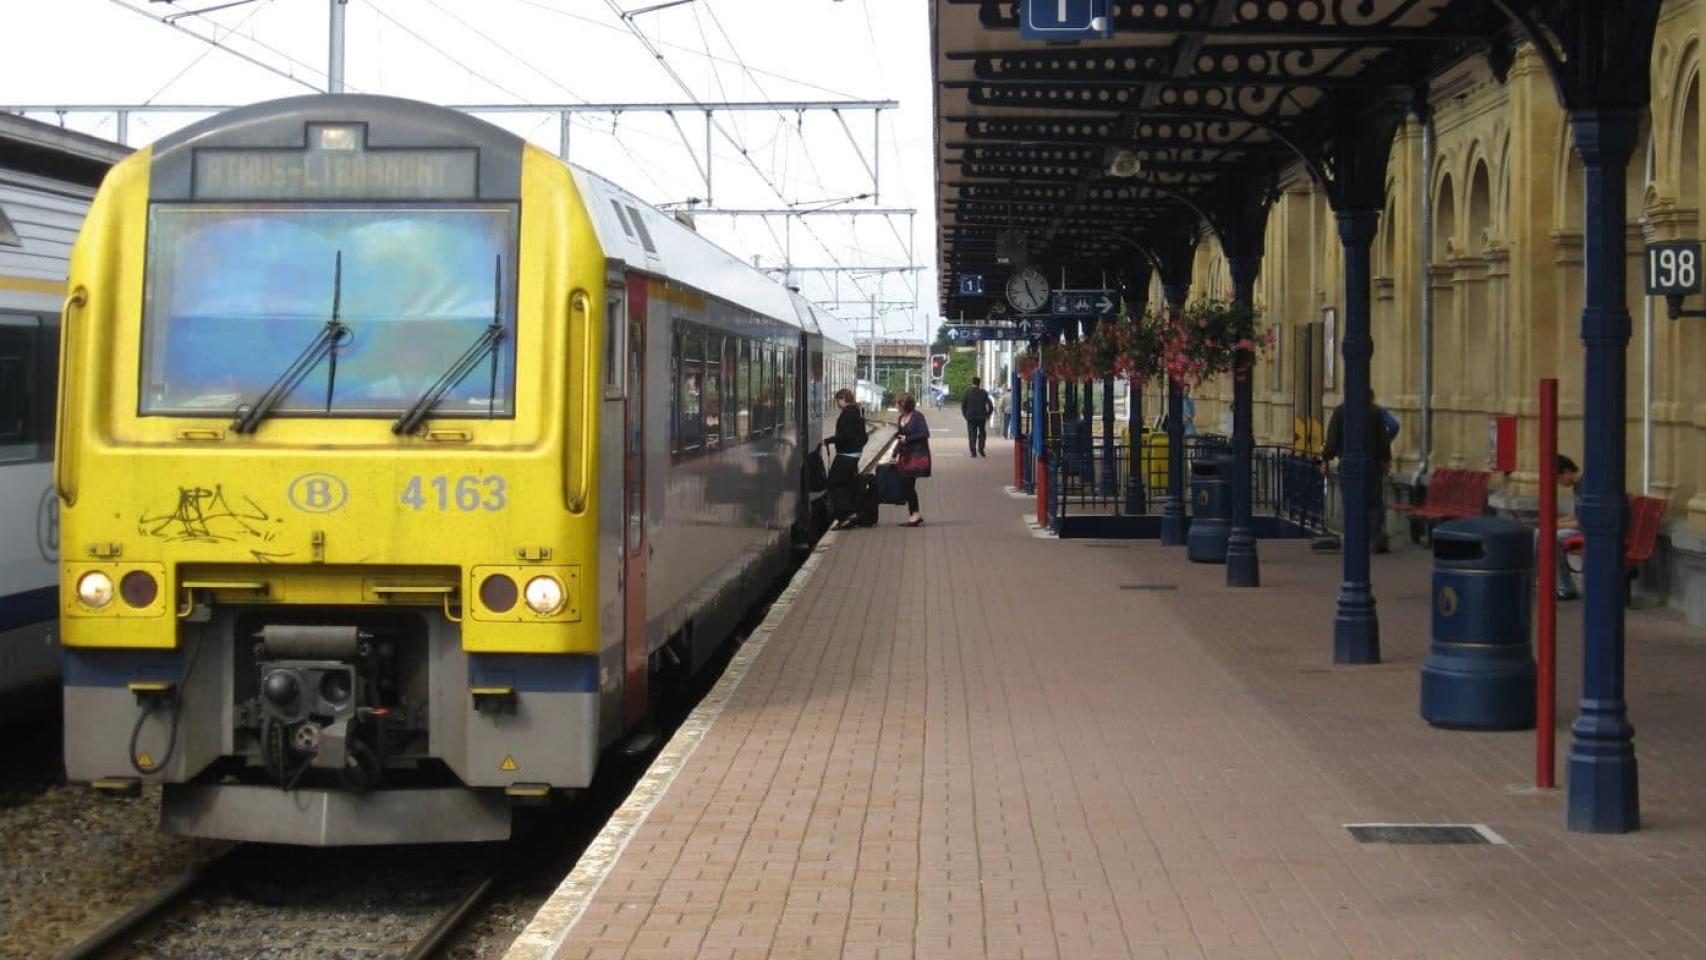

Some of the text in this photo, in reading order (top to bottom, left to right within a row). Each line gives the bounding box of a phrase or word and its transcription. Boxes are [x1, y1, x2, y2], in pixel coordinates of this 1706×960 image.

[1650, 249, 1695, 288] 198
[966, 279, 973, 292] 1
[305, 480, 331, 507] B
[400, 475, 506, 512] 4163
